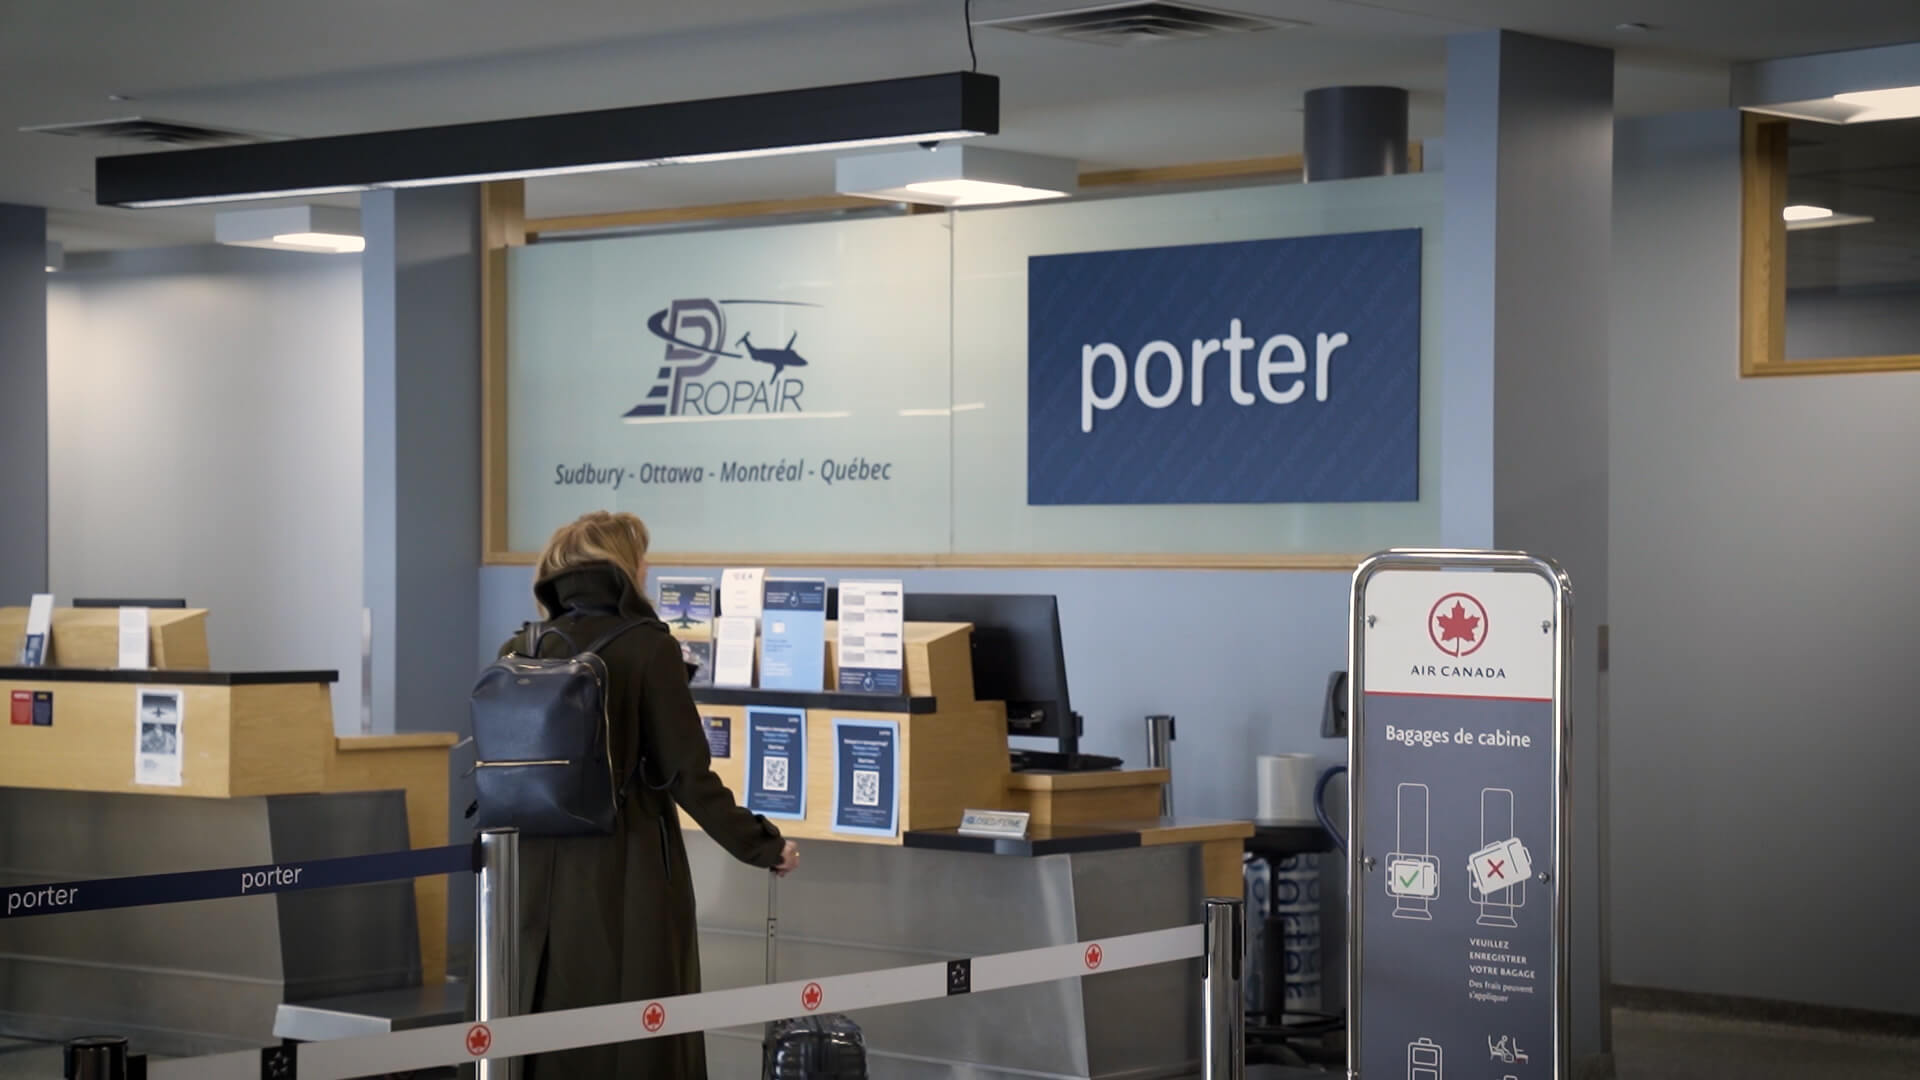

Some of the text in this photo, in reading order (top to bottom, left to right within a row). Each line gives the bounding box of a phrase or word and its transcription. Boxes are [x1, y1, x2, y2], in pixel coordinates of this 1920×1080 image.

[1081, 318, 1350, 434] porter
[555, 463, 625, 490] Sudbury
[639, 462, 703, 484] Ottawa
[720, 459, 803, 483] Montréal
[820, 457, 891, 485] Québec
[1410, 665, 1506, 679] AIR CANADA
[1385, 724, 1531, 747] Bagages de cabine
[242, 865, 303, 894] porter
[7, 885, 79, 915] porter
[1469, 937, 1509, 950] VEUILLEZ
[1468, 951, 1527, 964] ENREGISTRER
[1468, 965, 1536, 979] VOTRE BAGAGE
[1468, 979, 1483, 989] Des
